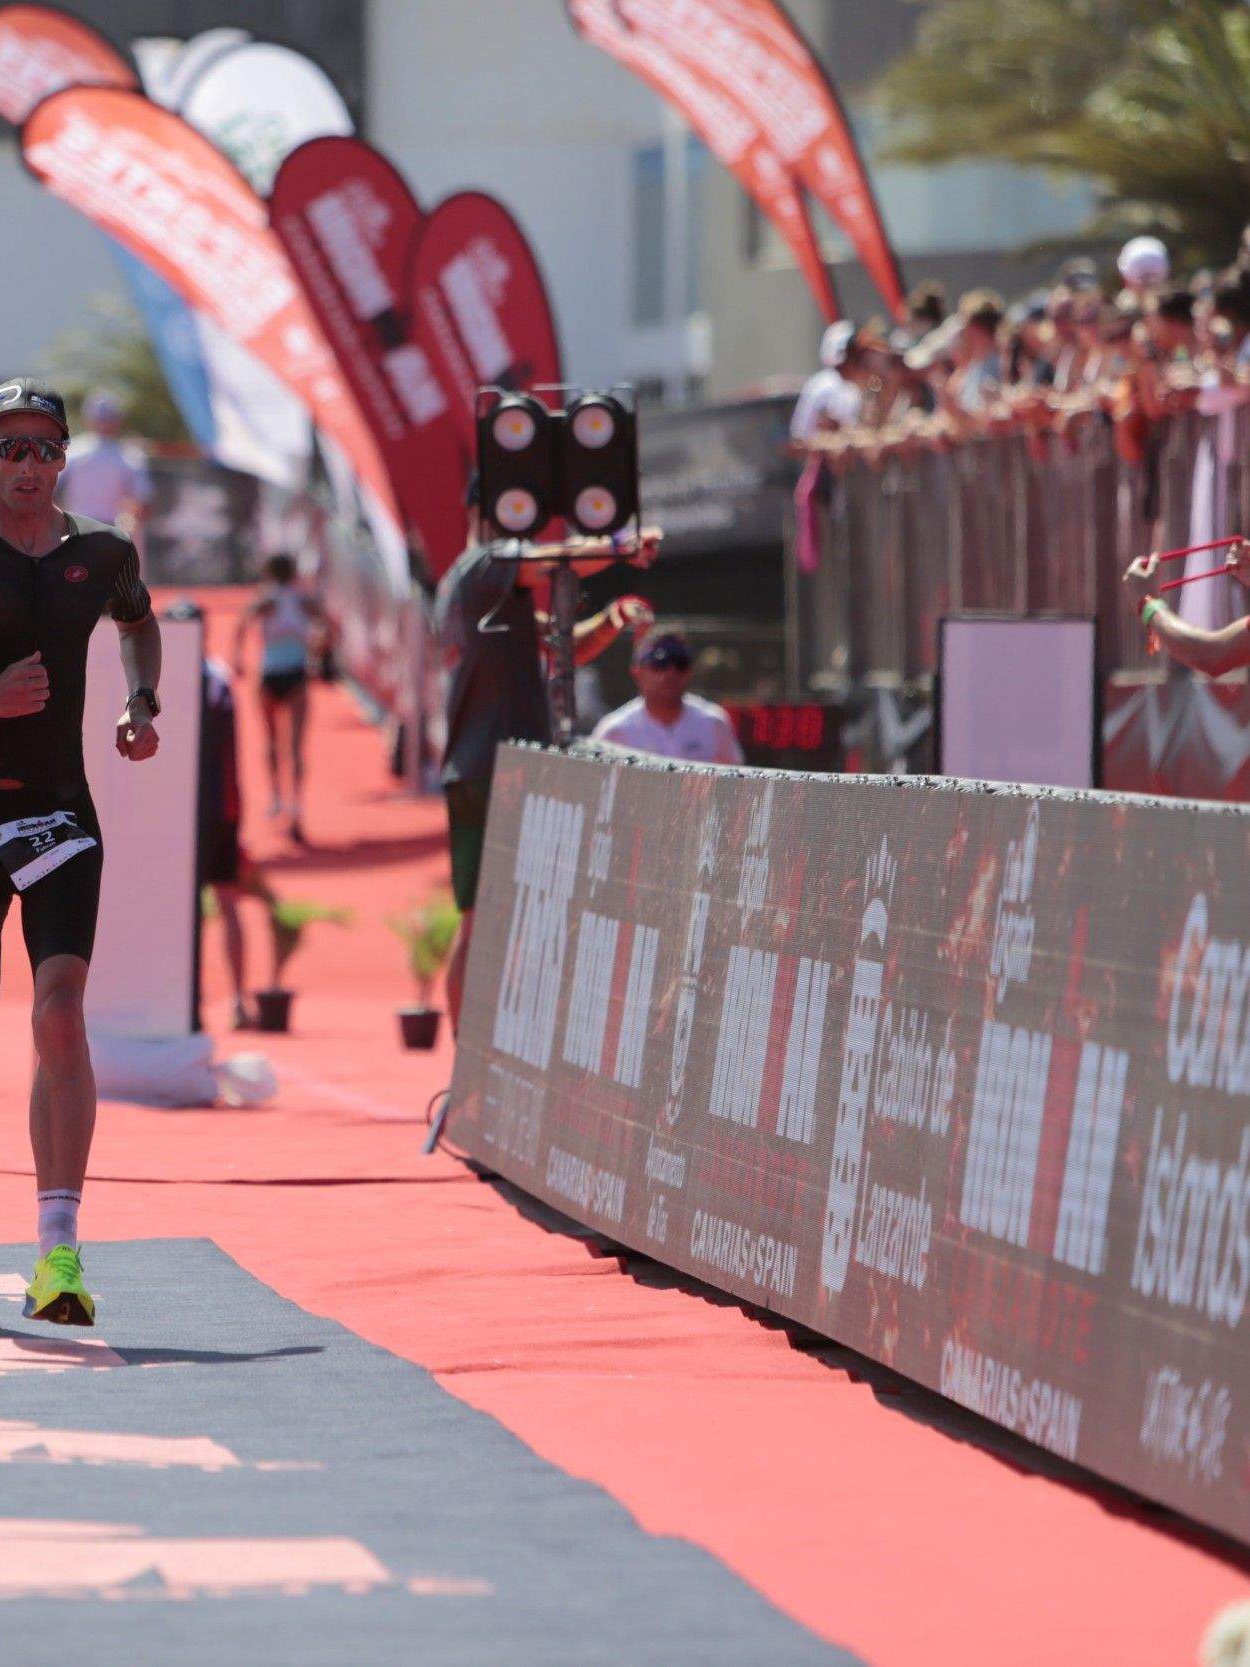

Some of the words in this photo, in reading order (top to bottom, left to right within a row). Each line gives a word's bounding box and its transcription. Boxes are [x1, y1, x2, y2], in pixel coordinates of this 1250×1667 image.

[28, 830, 56, 847] 22
[873, 1001, 932, 1130] Cabildo
[930, 1016, 956, 1136] de
[855, 1151, 932, 1291] Lanzarote
